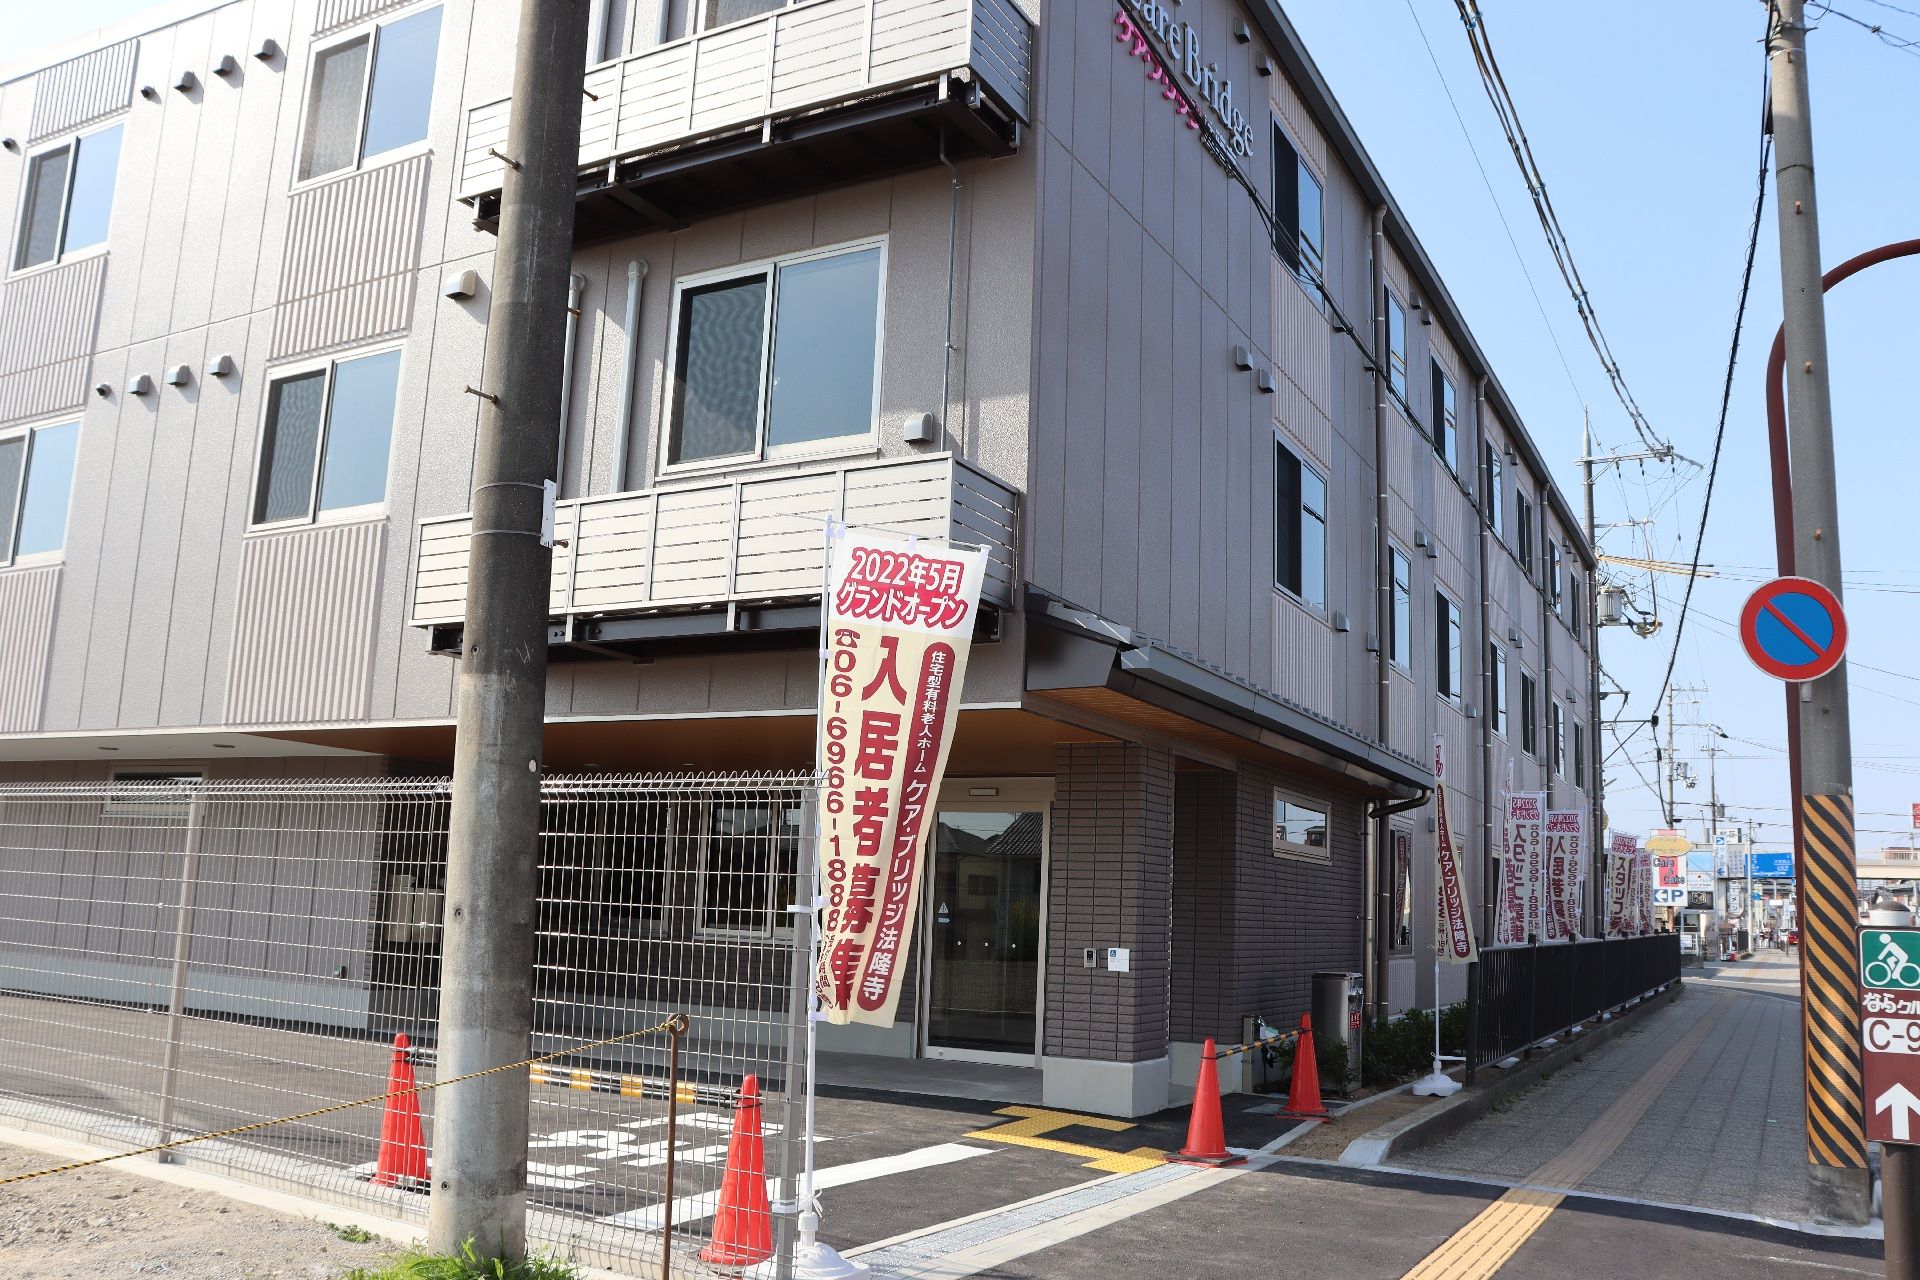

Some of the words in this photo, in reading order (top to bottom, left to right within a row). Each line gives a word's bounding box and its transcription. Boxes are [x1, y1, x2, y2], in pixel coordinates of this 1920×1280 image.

[1129, 0, 1181, 59] are
[1181, 21, 1255, 157] Bridge
[838, 580, 967, 629] グランドオープン
[850, 549, 961, 595] 2022年5月
[913, 650, 947, 774] 住宅型有料老人ホーム
[826, 649, 857, 932] 06-6966-1888
[831, 635, 907, 1011] 入居者募集
[863, 779, 927, 1001] ケア・ブリッジ法隆寺
[1441, 850, 1468, 953] ケア・ブリッジ法隆寺
[1671, 889, 1684, 902] P
[1869, 1019, 1920, 1052] C-9
